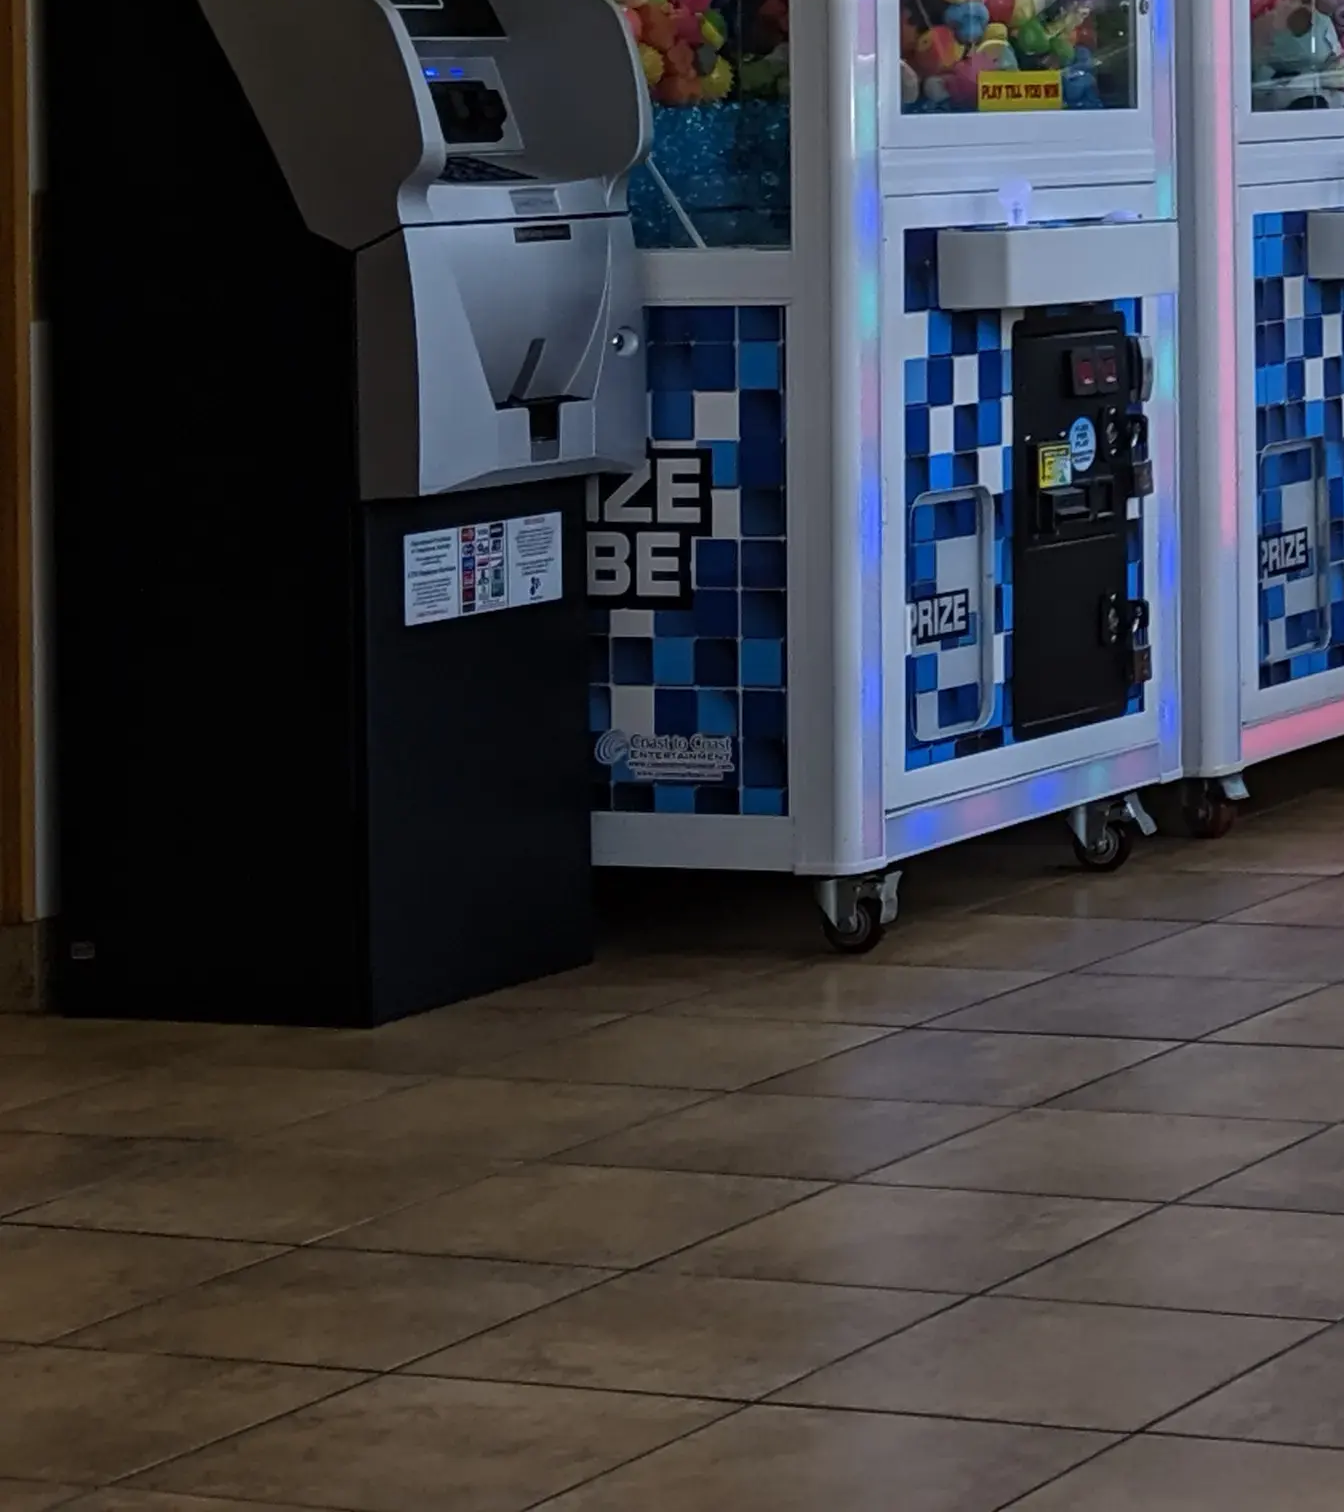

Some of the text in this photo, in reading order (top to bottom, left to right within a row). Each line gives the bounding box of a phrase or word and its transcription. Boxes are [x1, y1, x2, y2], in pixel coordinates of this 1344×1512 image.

[980, 84, 1002, 100] PLAY
[585, 457, 701, 523] IZE
[586, 531, 681, 597] BE
[630, 733, 732, 750] Coast to Coast
[631, 749, 731, 760] ENTERTAINMENT
